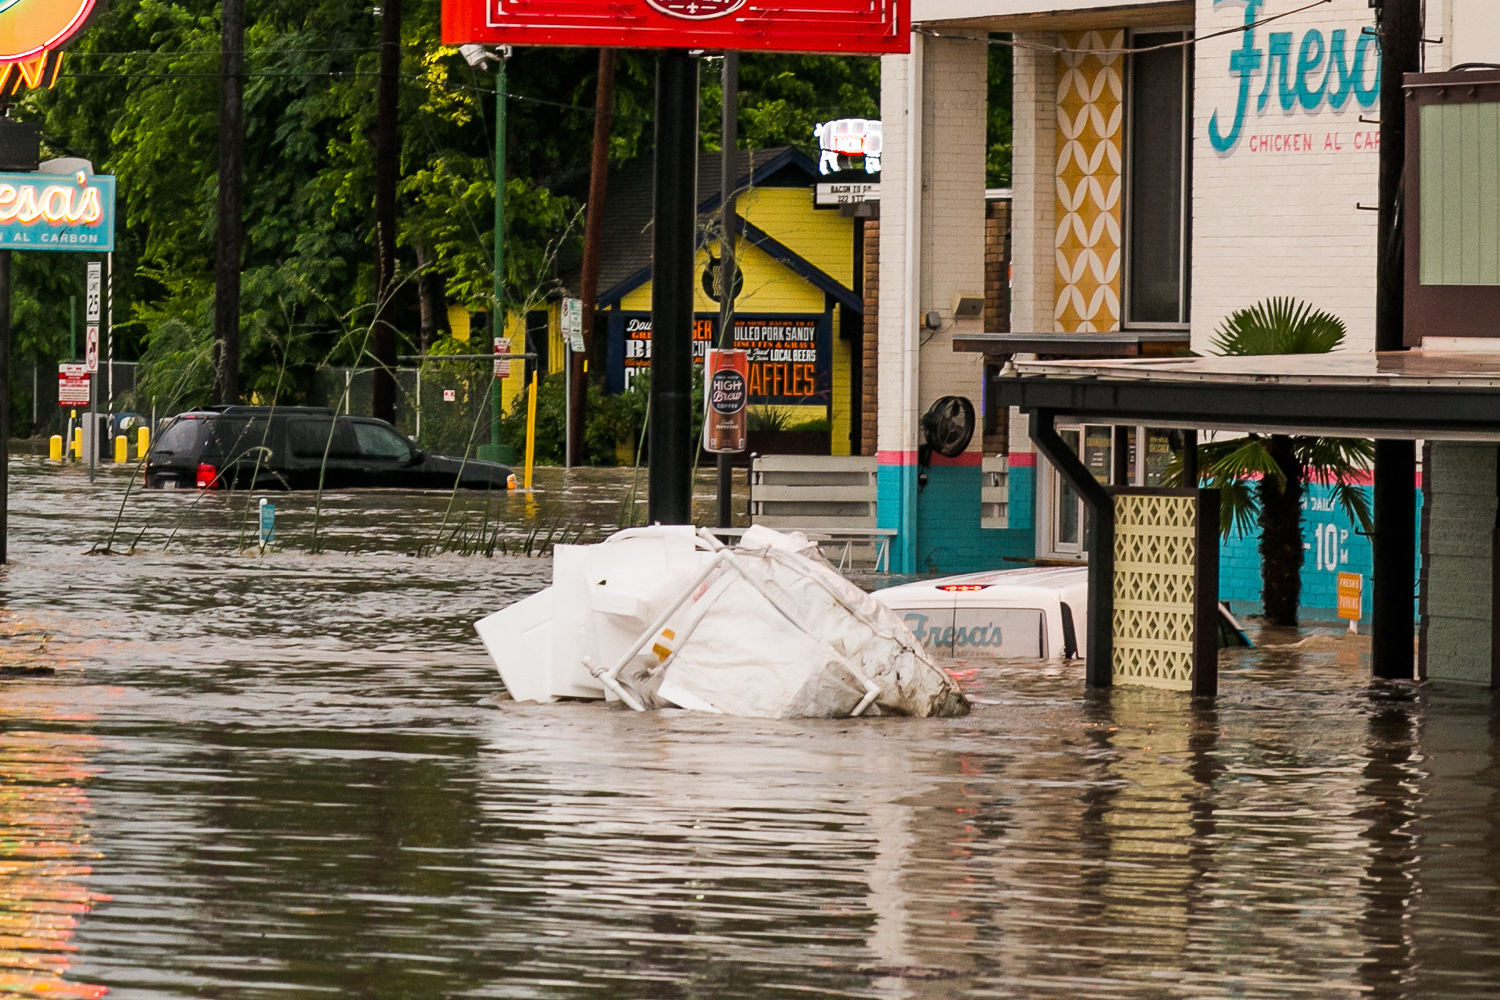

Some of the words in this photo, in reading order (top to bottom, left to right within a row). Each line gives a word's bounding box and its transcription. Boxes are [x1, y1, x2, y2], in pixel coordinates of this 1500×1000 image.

[1249, 133, 1311, 152] CHICKEN
[1324, 132, 1341, 150] AL
[13, 232, 30, 242] AL
[41, 232, 98, 243] CARBON
[88, 294, 99, 315] 25
[734, 326, 760, 340] ULLED
[761, 326, 784, 340] PORK
[785, 326, 815, 341] SANDY
[770, 349, 792, 361] LOCAL
[793, 349, 816, 362] BEERS
[713, 381, 742, 390] HIGH
[747, 363, 815, 395] AFFLES
[713, 390, 742, 402] Brew
[1311, 498, 1336, 511] DAILY
